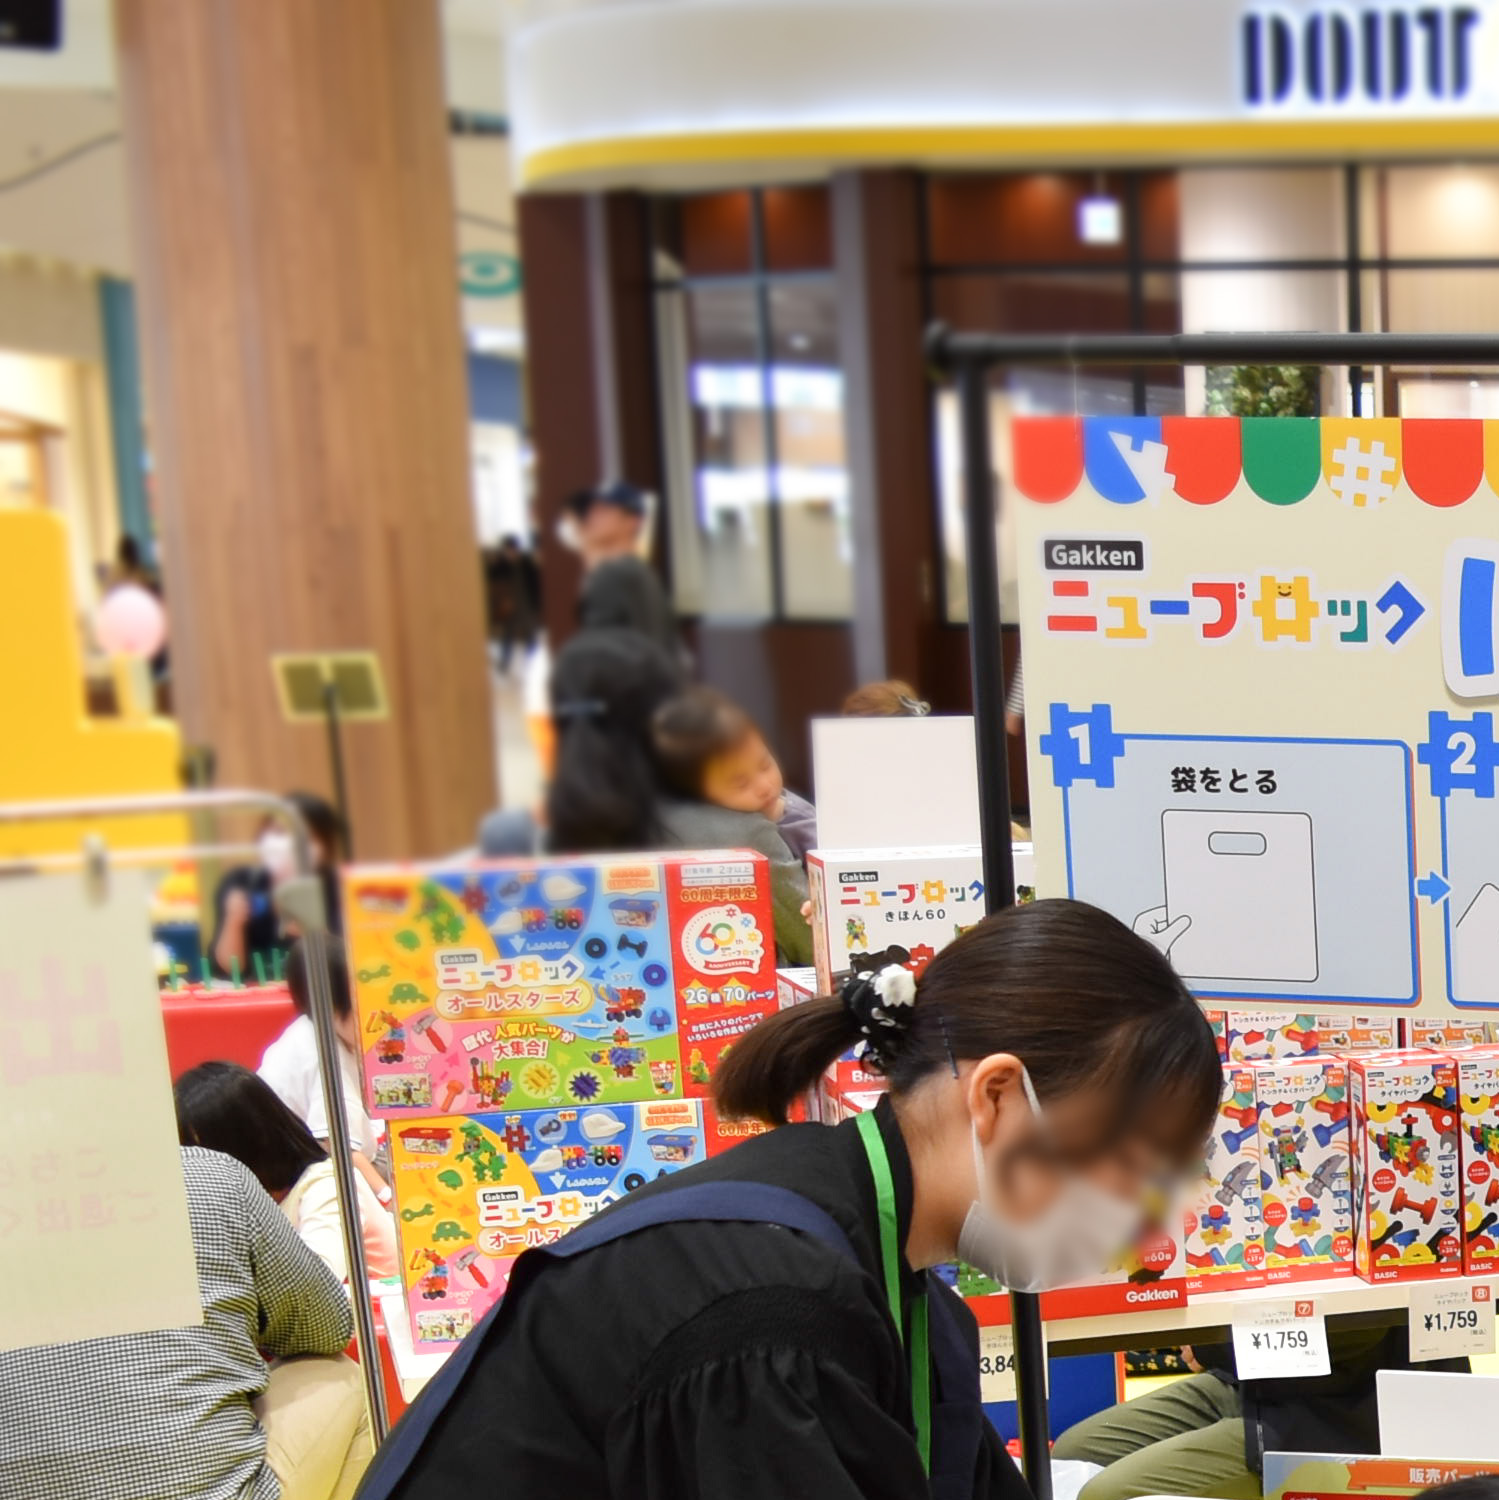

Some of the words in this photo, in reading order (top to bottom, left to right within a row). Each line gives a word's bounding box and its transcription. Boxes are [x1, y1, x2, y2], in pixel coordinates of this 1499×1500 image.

[1051, 544, 1136, 568] Gakken
[1047, 576, 1425, 644] ニューブロック
[1068, 723, 1091, 765] 1
[1447, 734, 1477, 775] 2
[1171, 767, 1278, 795] 袋をとる
[842, 872, 876, 882] Gakken
[841, 880, 985, 906] ニューブロック
[885, 908, 946, 922] きほん60
[443, 960, 578, 984] ニューブロック
[447, 989, 581, 1012] オールスターズ
[489, 1228, 575, 1248] オールス
[1267, 1271, 1291, 1280] BASIC
[1374, 1270, 1398, 1279] BASIC
[1470, 1262, 1493, 1271] BASIC
[1126, 1288, 1178, 1303] Gakken
[1424, 1310, 1478, 1332] ¥1,759
[1251, 1330, 1308, 1351] ¥1,759
